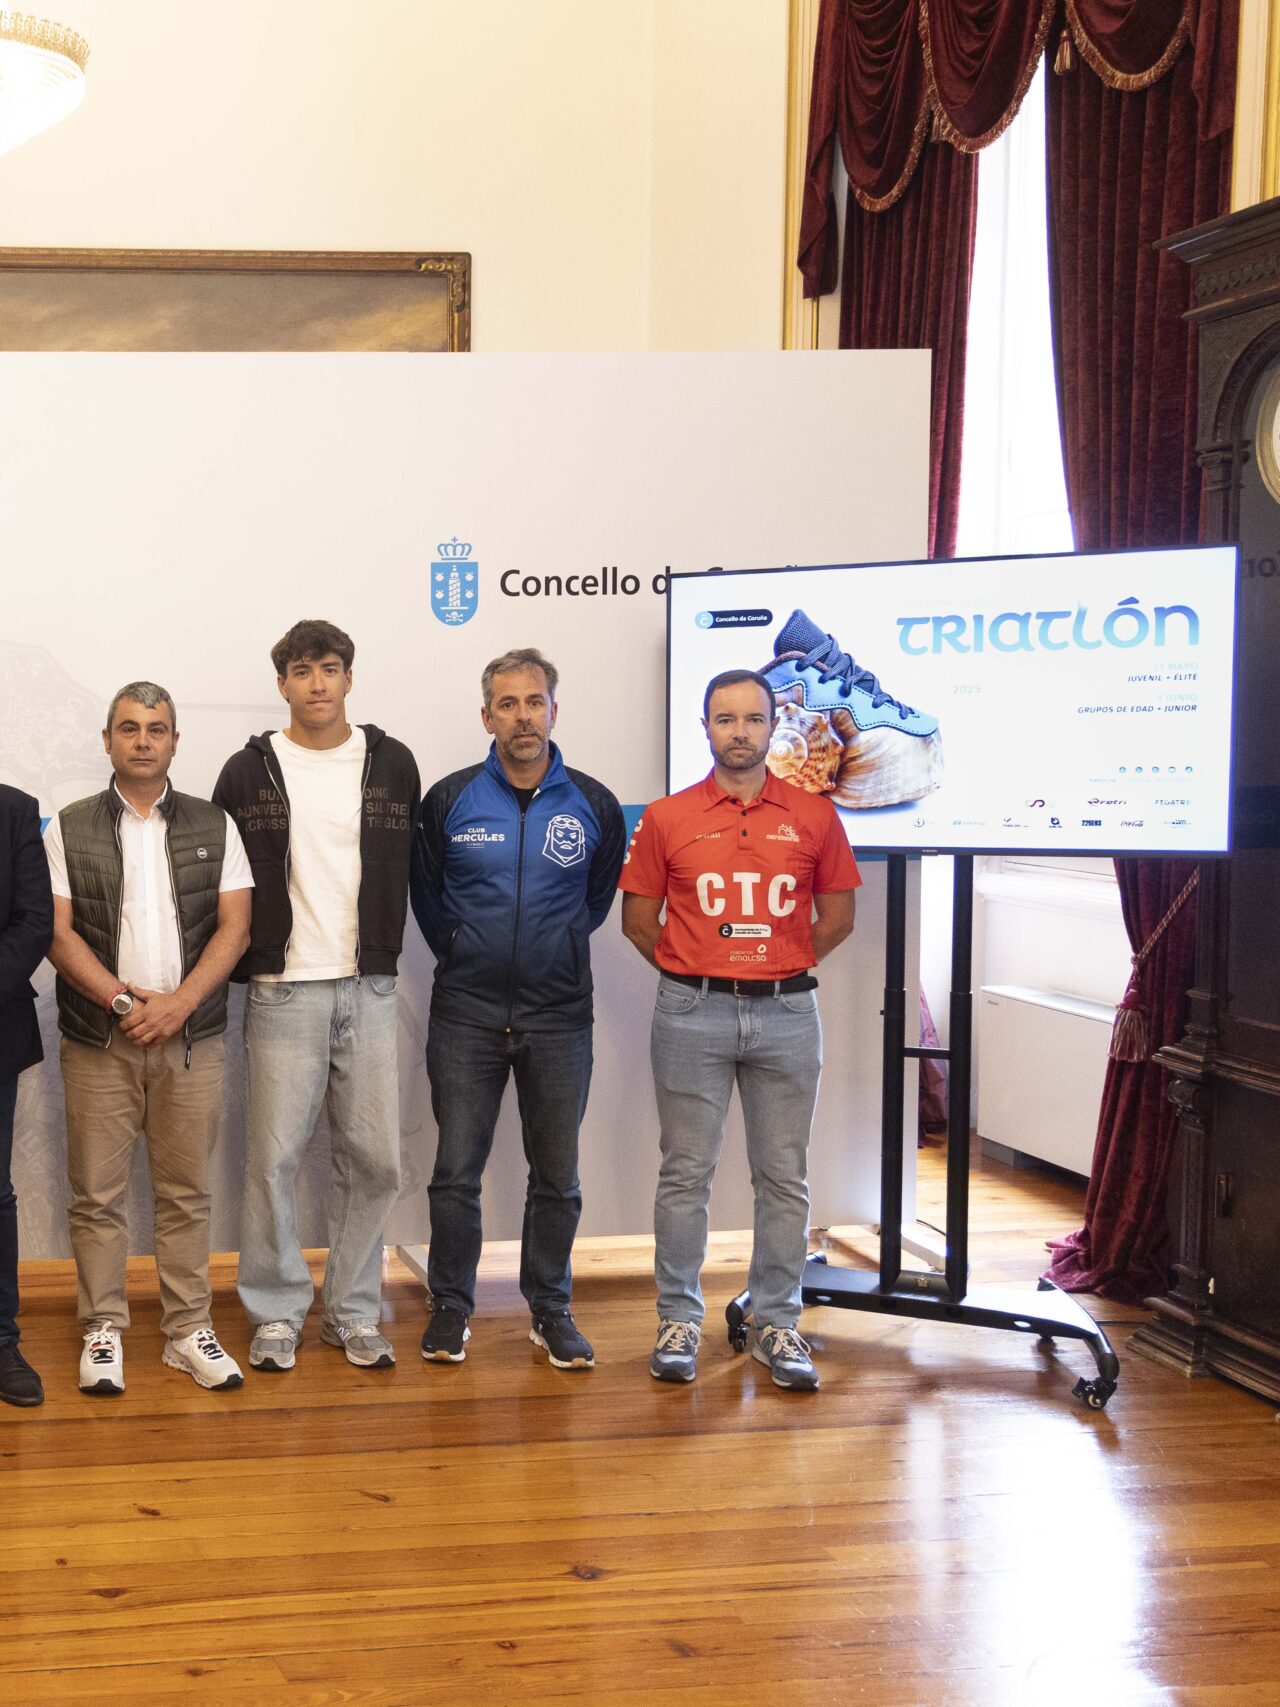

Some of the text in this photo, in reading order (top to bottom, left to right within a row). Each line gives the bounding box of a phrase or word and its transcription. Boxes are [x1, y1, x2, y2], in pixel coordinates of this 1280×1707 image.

[500, 567, 641, 597] Concello
[747, 614, 768, 622] Coruña
[1168, 661, 1199, 670] MAYO
[1127, 674, 1162, 683] JUVENIL
[951, 684, 982, 695] 2025
[1165, 693, 1198, 703] JUNIO
[1077, 706, 1114, 714] GRUPOS
[1116, 705, 1128, 713] DE
[1130, 705, 1154, 713] EDAD
[1163, 704, 1198, 713] JUNIOR
[451, 833, 506, 843] HERCULES
[696, 872, 797, 917] CTC
